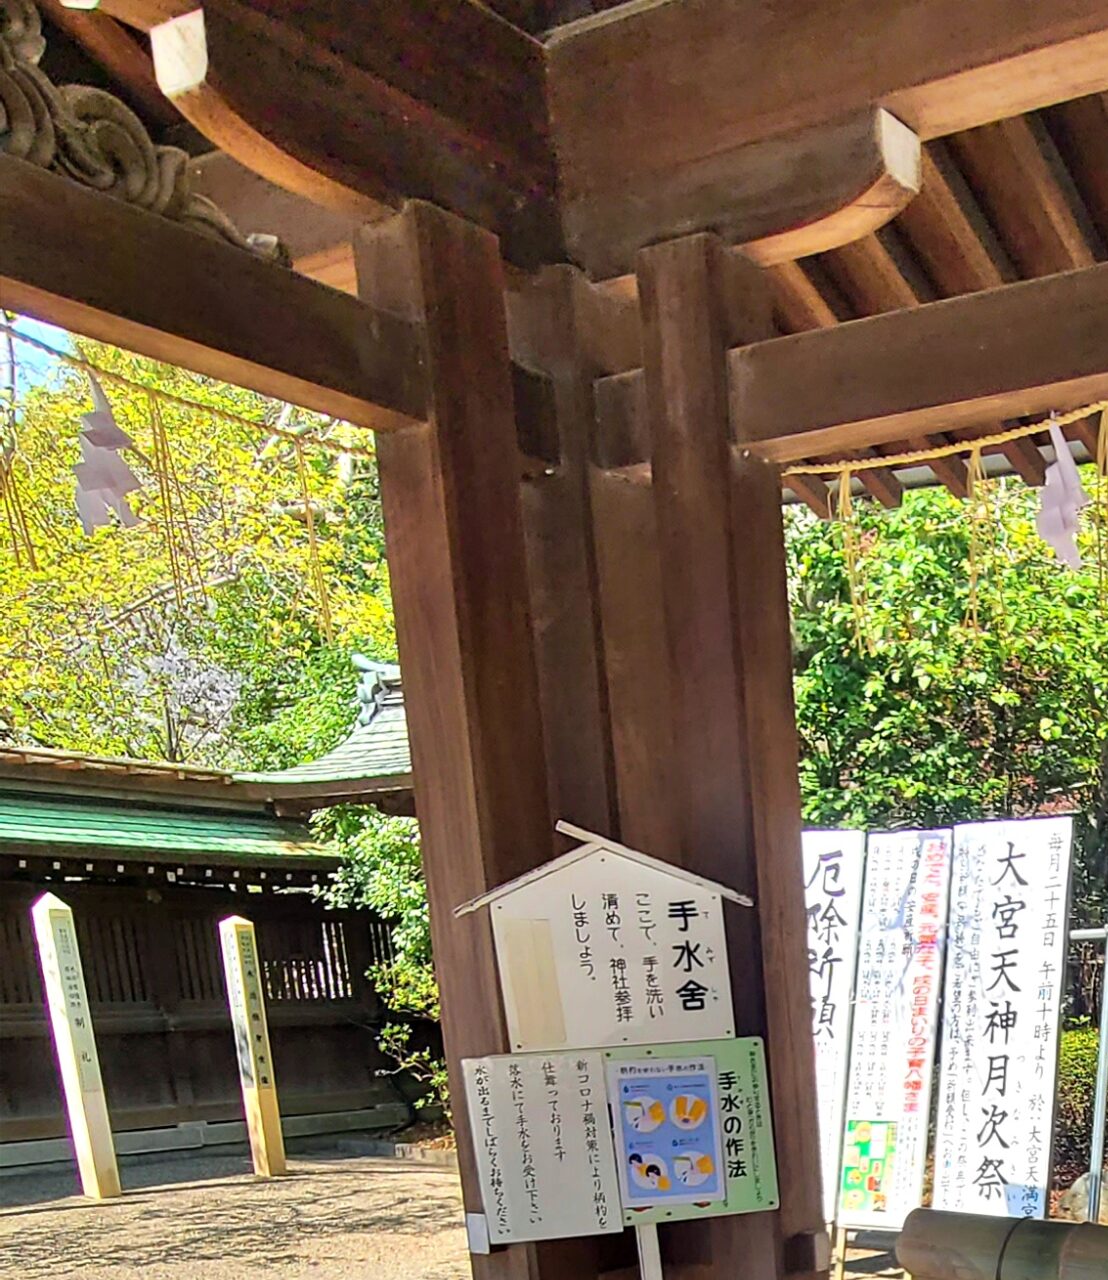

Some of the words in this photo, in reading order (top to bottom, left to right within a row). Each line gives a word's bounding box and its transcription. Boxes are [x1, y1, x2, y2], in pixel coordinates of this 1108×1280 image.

[570, 892, 597, 981] しましょう。
[667, 899, 709, 1011] 手水舎
[971, 840, 1029, 1201] 大宮天神月次祭
[473, 1064, 511, 1236] 水が出るまでしばらくお待ちください
[540, 1060, 567, 1163] 仕舞っております
[717, 1070, 748, 1179] 手水の作法
